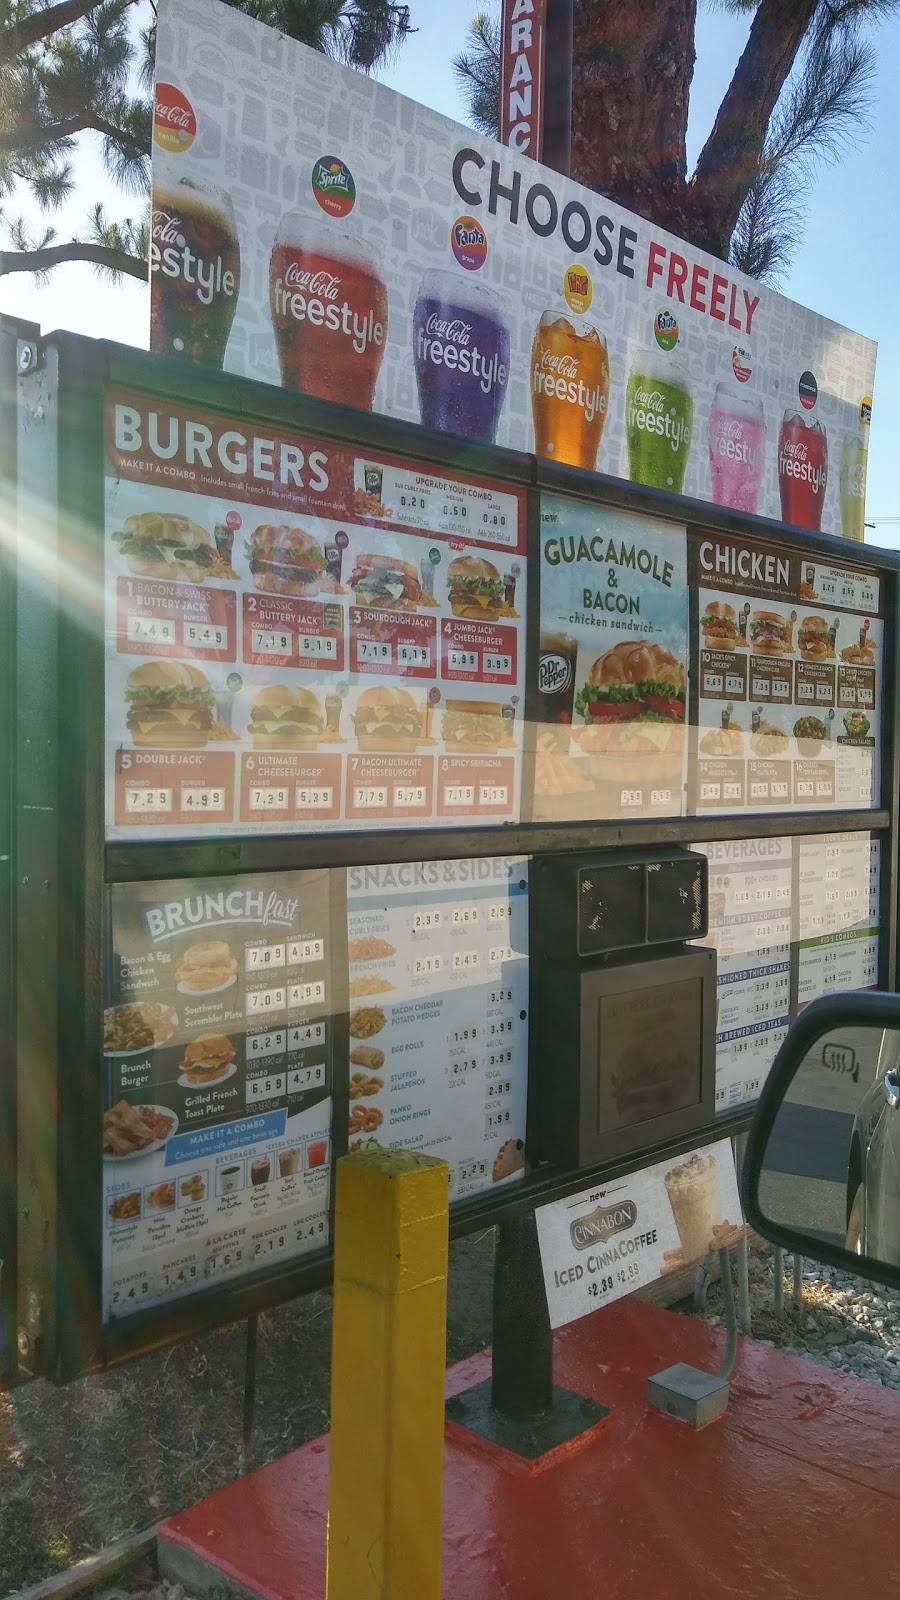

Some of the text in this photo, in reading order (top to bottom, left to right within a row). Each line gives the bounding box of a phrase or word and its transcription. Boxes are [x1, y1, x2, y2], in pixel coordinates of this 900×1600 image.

[321, 170, 346, 190] Sprite
[452, 147, 761, 335] CHOOSE FREELY
[455, 223, 486, 247] Fanta
[285, 262, 344, 300] Coca-Cola
[274, 277, 384, 353] freestyle
[656, 312, 677, 330] Fanta
[425, 311, 473, 349] Coca-Cola
[417, 327, 507, 393] freestyle
[540, 348, 580, 379] Coca-Cola
[533, 360, 607, 422] freestyle
[633, 386, 667, 412] Coca-Cola
[114, 403, 330, 493] BURGERS
[783, 440, 808, 461] Coca-Cola
[119, 457, 144, 471] MAKE
[163, 464, 196, 481] COMBO
[778, 449, 826, 495] freestyle
[415, 476, 493, 502] UPGRADE YOUR COMBO
[400, 496, 426, 509] 0.20
[443, 505, 468, 517] 0.50
[483, 513, 506, 526] 0.80
[544, 535, 675, 588] GUACAMOLE
[699, 541, 790, 587] CHICKEN
[607, 567, 619, 589] &
[126, 581, 134, 598] 1
[136, 581, 176, 597] BACON
[136, 596, 181, 610] BUTTERY
[247, 597, 293, 612] 2 CLASSIC
[583, 587, 641, 616] BACON
[259, 609, 296, 623] BUTTERY
[353, 611, 362, 625] 3
[363, 611, 410, 626] SOURDOUGH
[569, 611, 654, 634] chicken sandwich
[134, 622, 170, 637] 7.49
[444, 621, 453, 635] 4
[453, 623, 477, 635] JUMBO
[189, 629, 222, 644] 5.49
[257, 634, 288, 649] 7.19
[453, 633, 503, 647] CHEESEBURGER
[361, 644, 388, 657] 7.19
[538, 661, 569, 689] Pepper
[546, 659, 560, 676] Dr
[120, 754, 133, 770] 5
[135, 754, 176, 766] DOUBLE
[246, 756, 298, 771] 6 ULTIMATE
[351, 757, 422, 771] 7 BACON ULTIMATE
[441, 759, 449, 771] 8
[257, 767, 322, 778] CHEESEBURGER
[361, 768, 417, 778] CHEESEBURGER
[131, 792, 167, 807] 7.29
[186, 792, 220, 808] 4.99
[255, 791, 284, 805] 7.39
[300, 791, 329, 803] 5.39
[358, 790, 384, 802] 7.79
[397, 789, 422, 801] 5.79
[706, 838, 783, 860] BEVERAGES
[349, 914, 385, 926] SEASONED
[416, 913, 440, 926] 2.39
[454, 911, 478, 922] 2.69
[252, 948, 282, 963] 7.09
[292, 943, 321, 957] 4.99
[120, 951, 172, 966] Bacon Egg
[416, 959, 440, 972] 2.19
[455, 954, 478, 967] 2.49
[120, 966, 155, 979] Chicken
[749, 967, 767, 980] THICK
[768, 961, 791, 975] SHAKES
[120, 978, 161, 992] Sandwich
[292, 985, 321, 1000] 4.99
[252, 991, 282, 1007] 7.09
[184, 1001, 225, 1016] Southwest
[391, 999, 444, 1017] BACON CHEDDAR
[184, 1015, 224, 1029] Scrambler
[224, 1010, 244, 1023] Plate
[391, 1009, 441, 1026] POTATO WEDGES
[293, 1026, 322, 1042] 4.49
[723, 1018, 782, 1040] BREWED ICED TEAS
[252, 1034, 283, 1051] 6.29
[391, 1040, 425, 1054] EGG ROLLS
[120, 1061, 152, 1075] Brunch
[246, 1062, 304, 1081] COMBO PLATE
[390, 1069, 418, 1083] STUFFED
[120, 1075, 150, 1089] Burger
[293, 1069, 322, 1085] 4.79
[252, 1078, 283, 1095] 6.59
[184, 1087, 239, 1108] Grilled French
[184, 1103, 226, 1120] Toast Plate
[389, 1107, 431, 1126] ONION RINGS
[390, 1103, 412, 1116] PANKO
[190, 1119, 265, 1145] MAKE IT COMBO
[403, 1133, 424, 1147] SALAD
[215, 1147, 257, 1165] BEVERAGES
[105, 1181, 132, 1194] SIDES
[589, 1190, 607, 1203] new
[263, 1223, 289, 1238] COOLER
[296, 1222, 325, 1242] 2.49
[573, 1207, 633, 1245] CINNABON
[222, 1227, 248, 1243] CARTE
[212, 1240, 240, 1254] MUFFINS
[254, 1236, 285, 1256] 2.19
[162, 1254, 197, 1271] PANCAKES
[112, 1270, 147, 1288] POTATOES
[164, 1265, 197, 1286] 1.49
[554, 1264, 584, 1289] ICED
[112, 1281, 149, 1304] 2.49
[587, 1275, 615, 1298] $2.39
